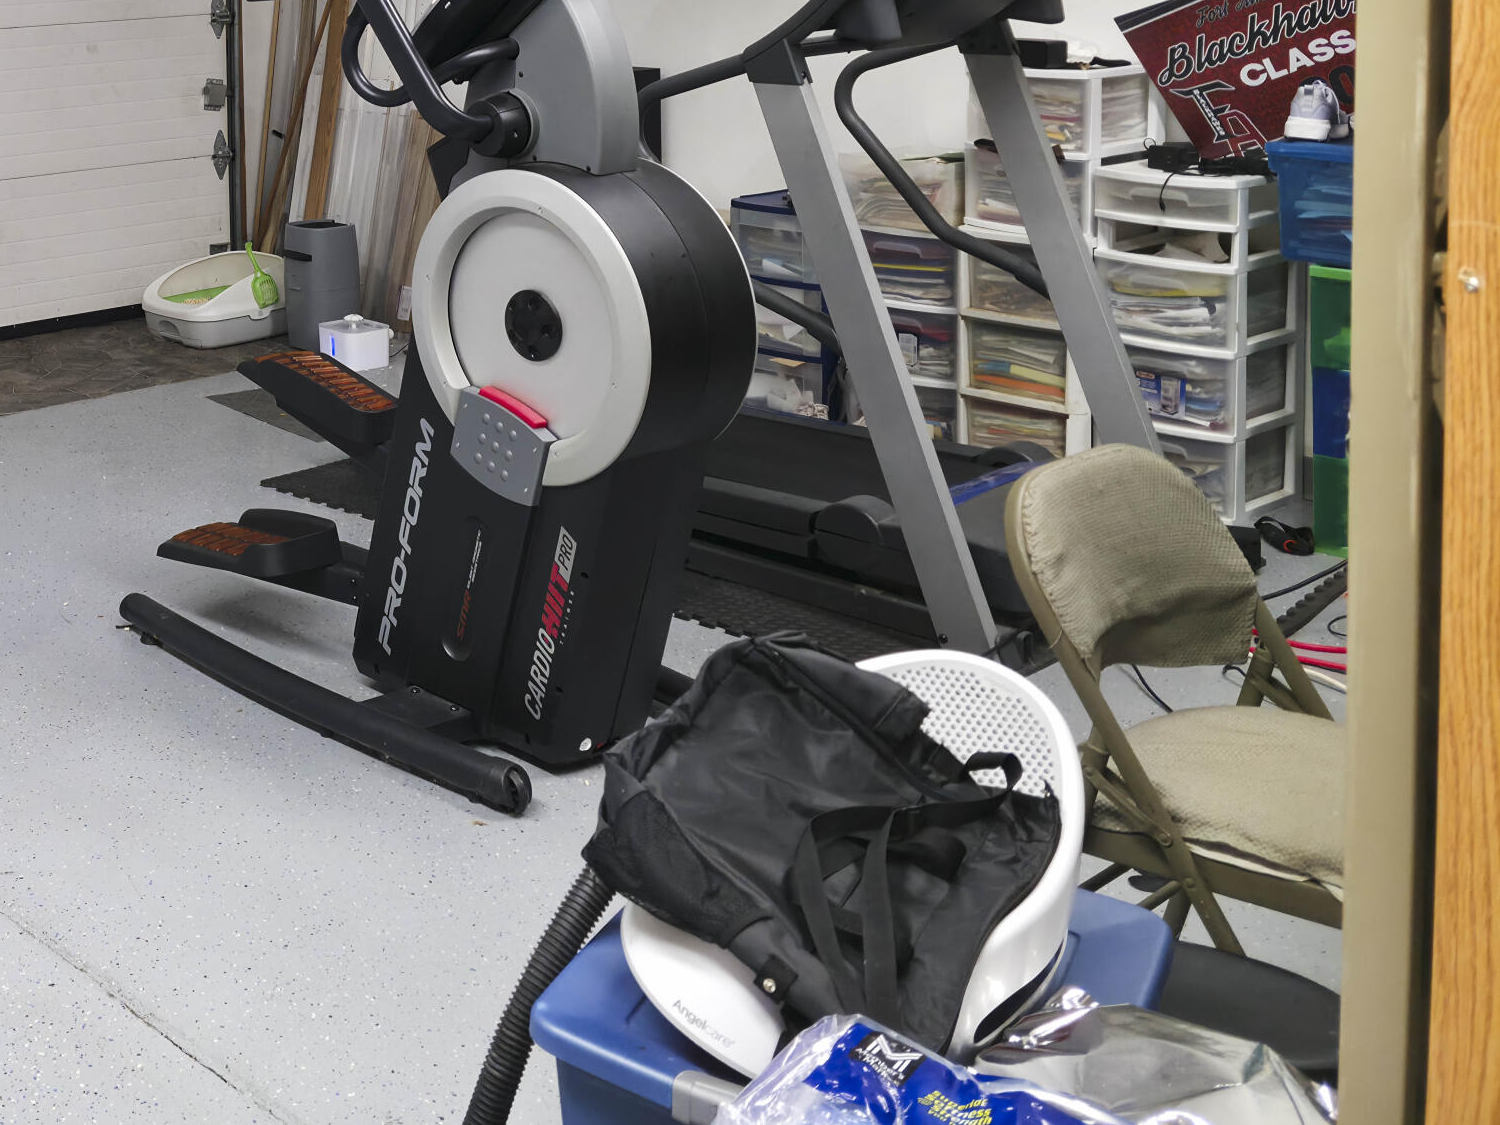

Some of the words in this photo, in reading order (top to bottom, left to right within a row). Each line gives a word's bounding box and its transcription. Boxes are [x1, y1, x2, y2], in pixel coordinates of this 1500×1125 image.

[1240, 29, 1357, 86] CLASS
[378, 417, 435, 655] PRO-FORM
[557, 533, 575, 571] PRO
